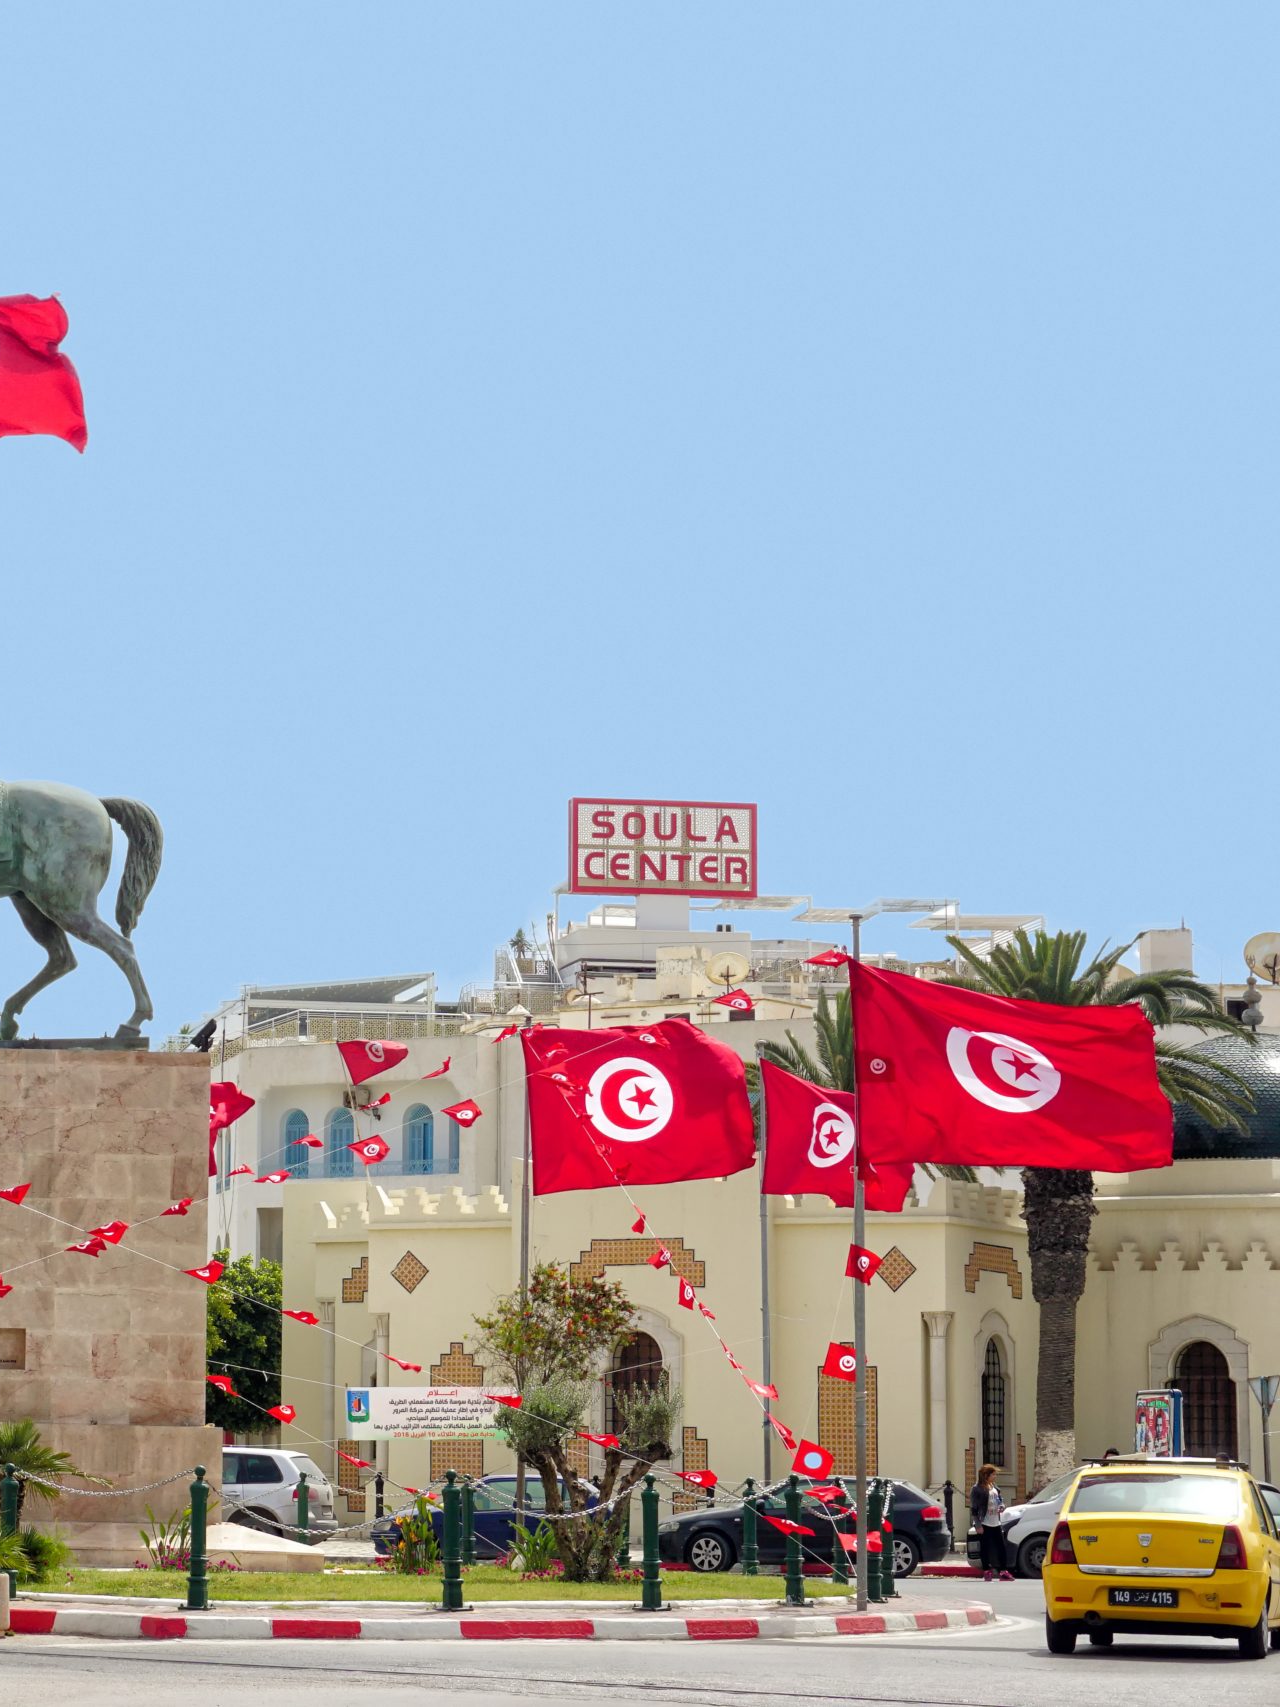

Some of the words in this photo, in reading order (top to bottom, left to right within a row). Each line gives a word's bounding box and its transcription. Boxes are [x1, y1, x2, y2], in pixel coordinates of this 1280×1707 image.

[591, 810, 739, 843] SOULA
[584, 852, 748, 884] CENTER
[1114, 1590, 1130, 1602] 149
[1151, 1592, 1173, 1604] 4115
